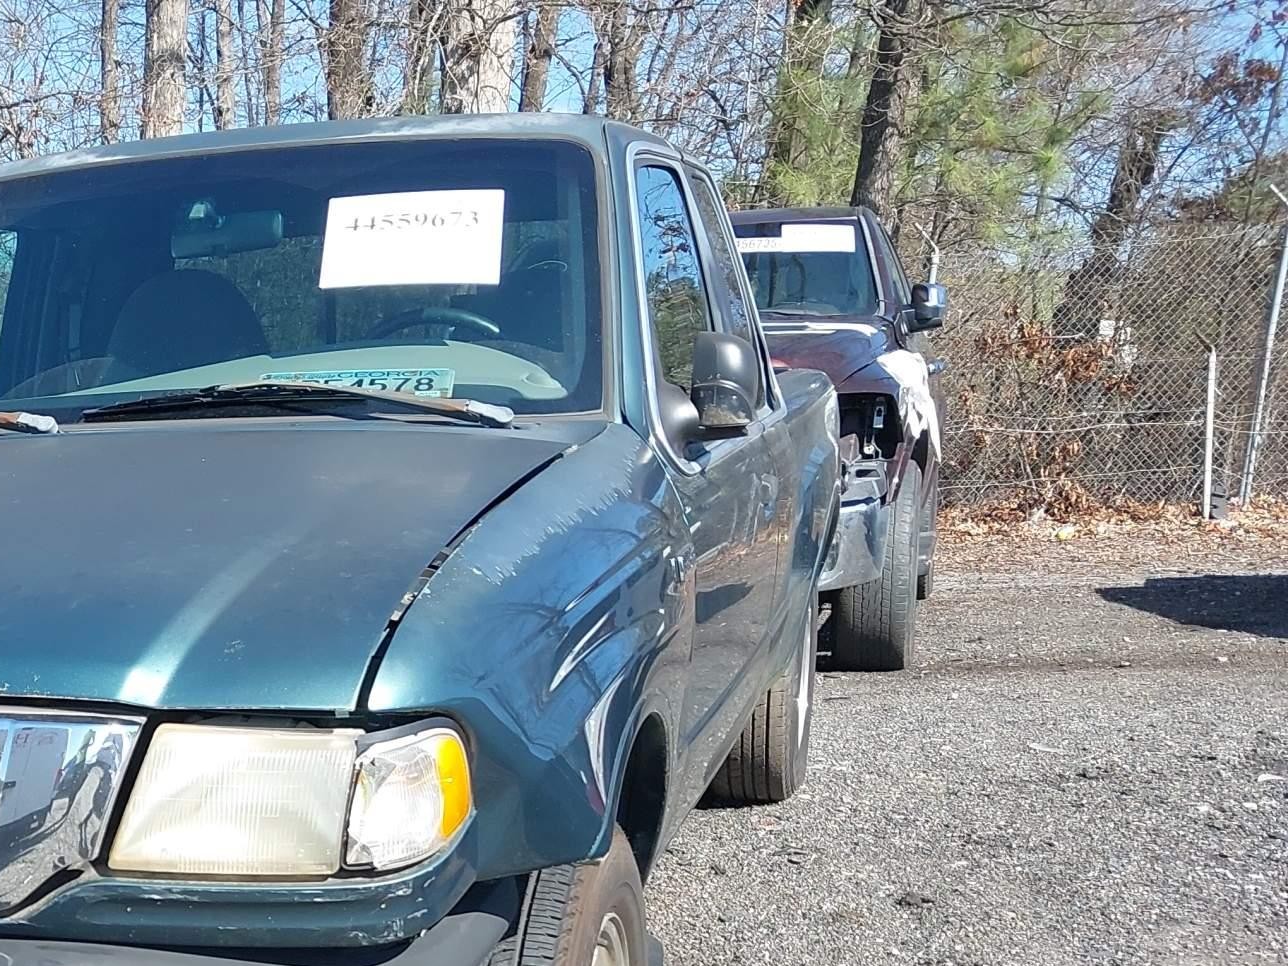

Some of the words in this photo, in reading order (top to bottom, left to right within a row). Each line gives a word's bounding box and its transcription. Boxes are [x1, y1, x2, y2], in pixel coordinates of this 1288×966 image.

[344, 210, 480, 232] 44559673
[337, 369, 441, 379] GEORGIA
[302, 377, 435, 392] 4578
